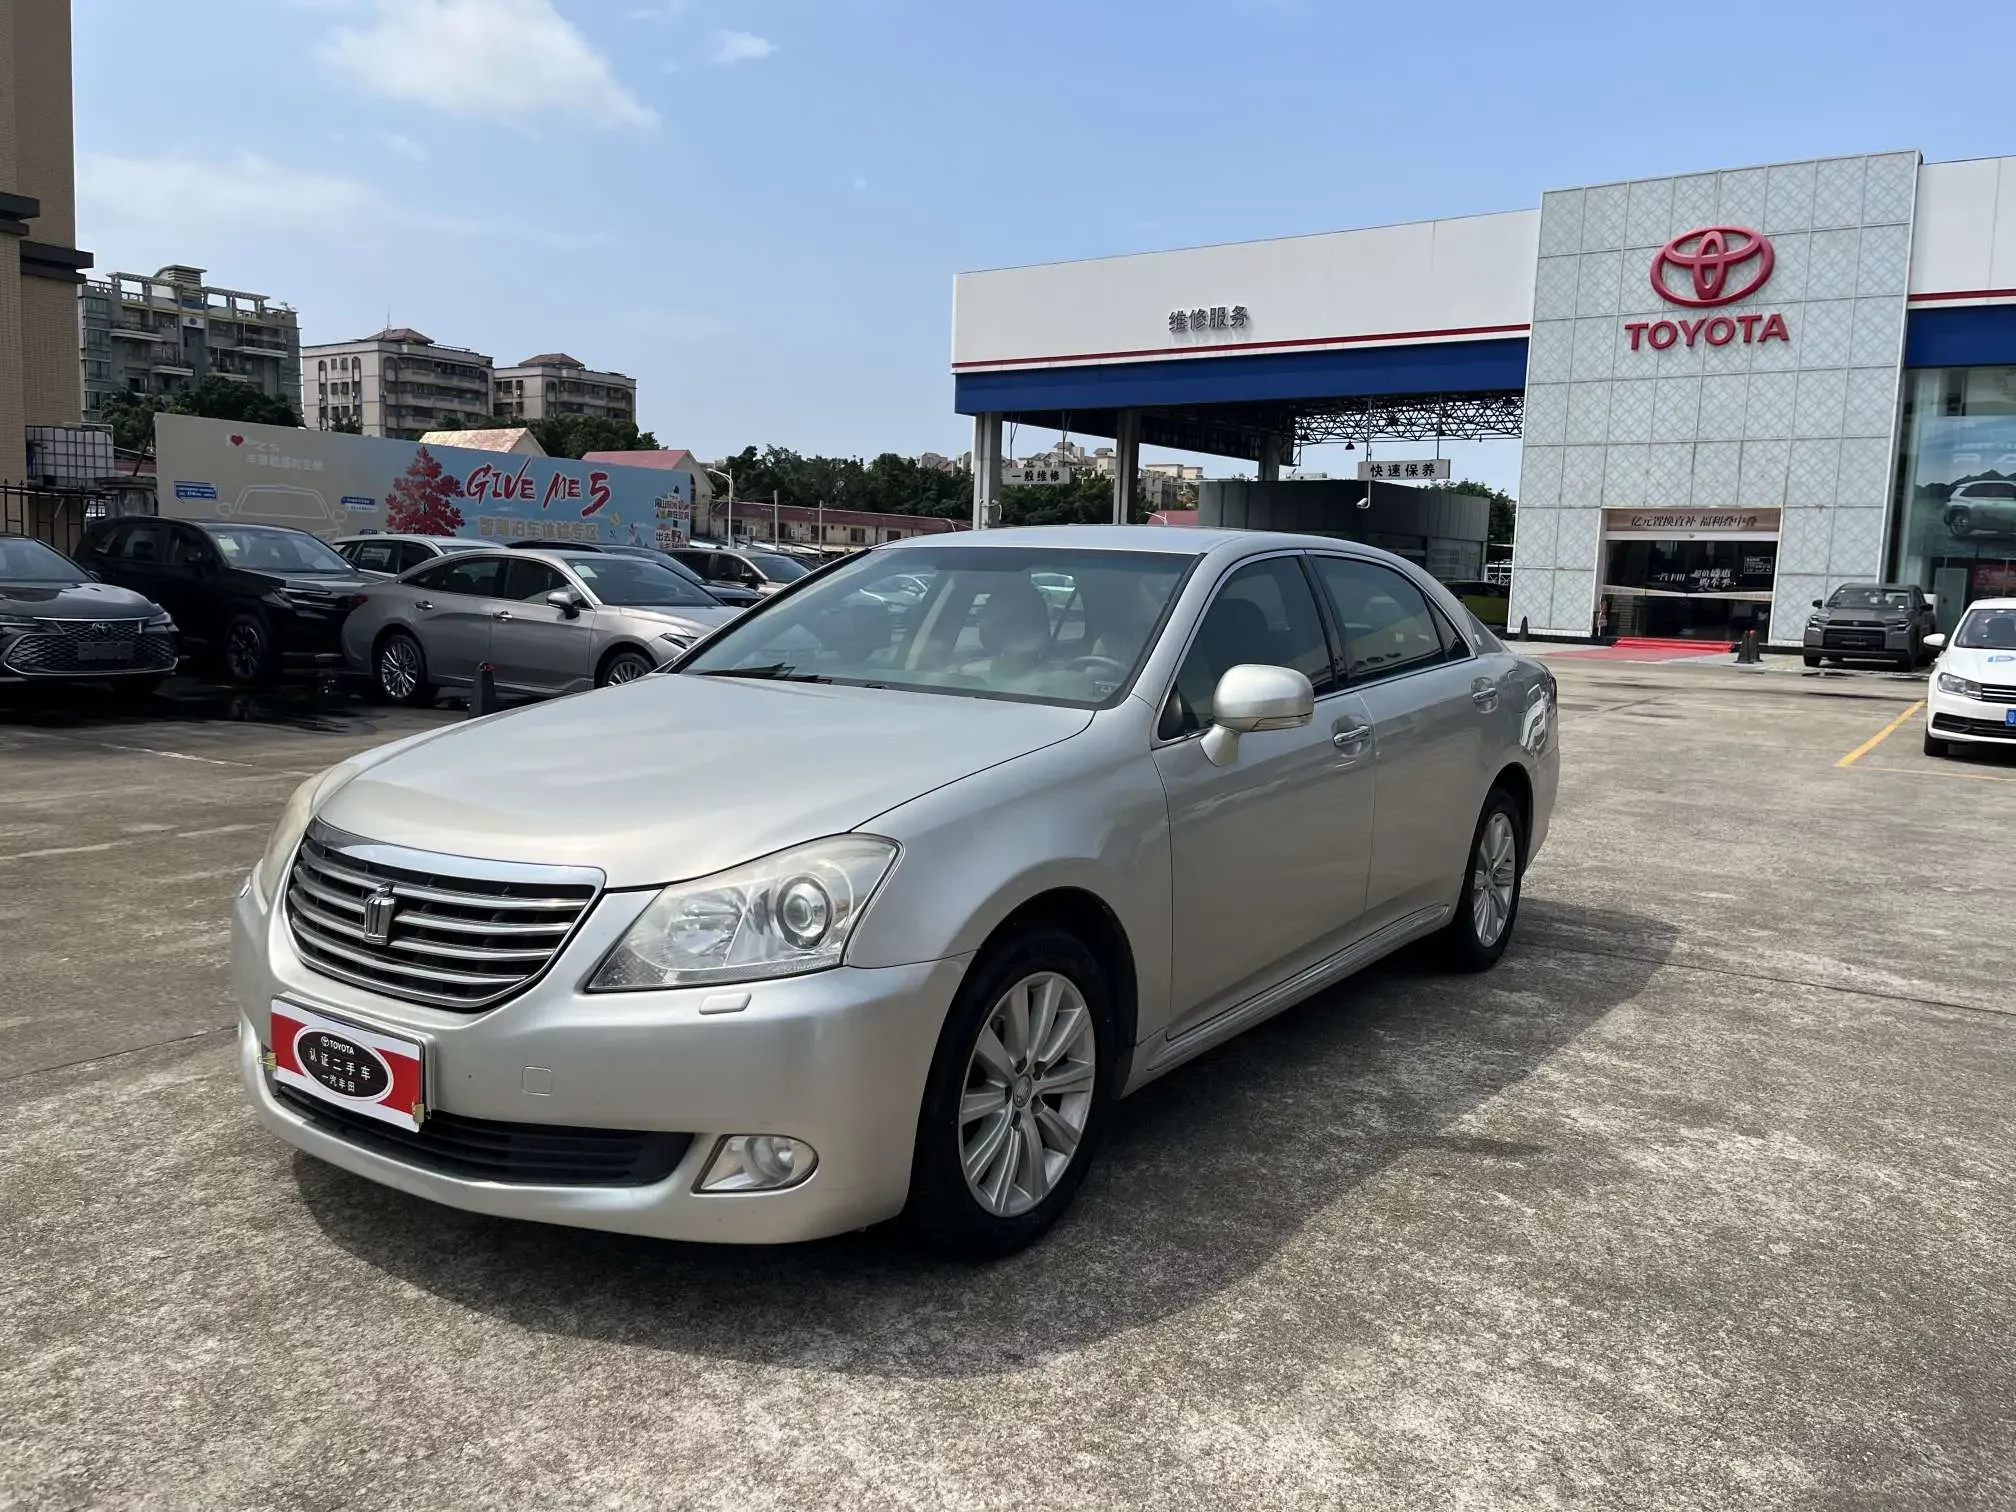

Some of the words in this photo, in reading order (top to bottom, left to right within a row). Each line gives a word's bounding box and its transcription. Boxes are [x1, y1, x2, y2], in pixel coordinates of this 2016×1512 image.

[1168, 305, 1249, 333] 维修服务
[1624, 313, 1790, 351] TOYOTA
[1011, 470, 1060, 482] 一般维修
[1370, 463, 1436, 478] 快速保养
[466, 456, 536, 504] GIVE
[541, 472, 582, 509] ME
[581, 472, 612, 518] 5
[329, 1038, 355, 1056] TOYOTA
[308, 1047, 371, 1081] 认证二手车
[320, 1074, 355, 1093] 一汽丰田
